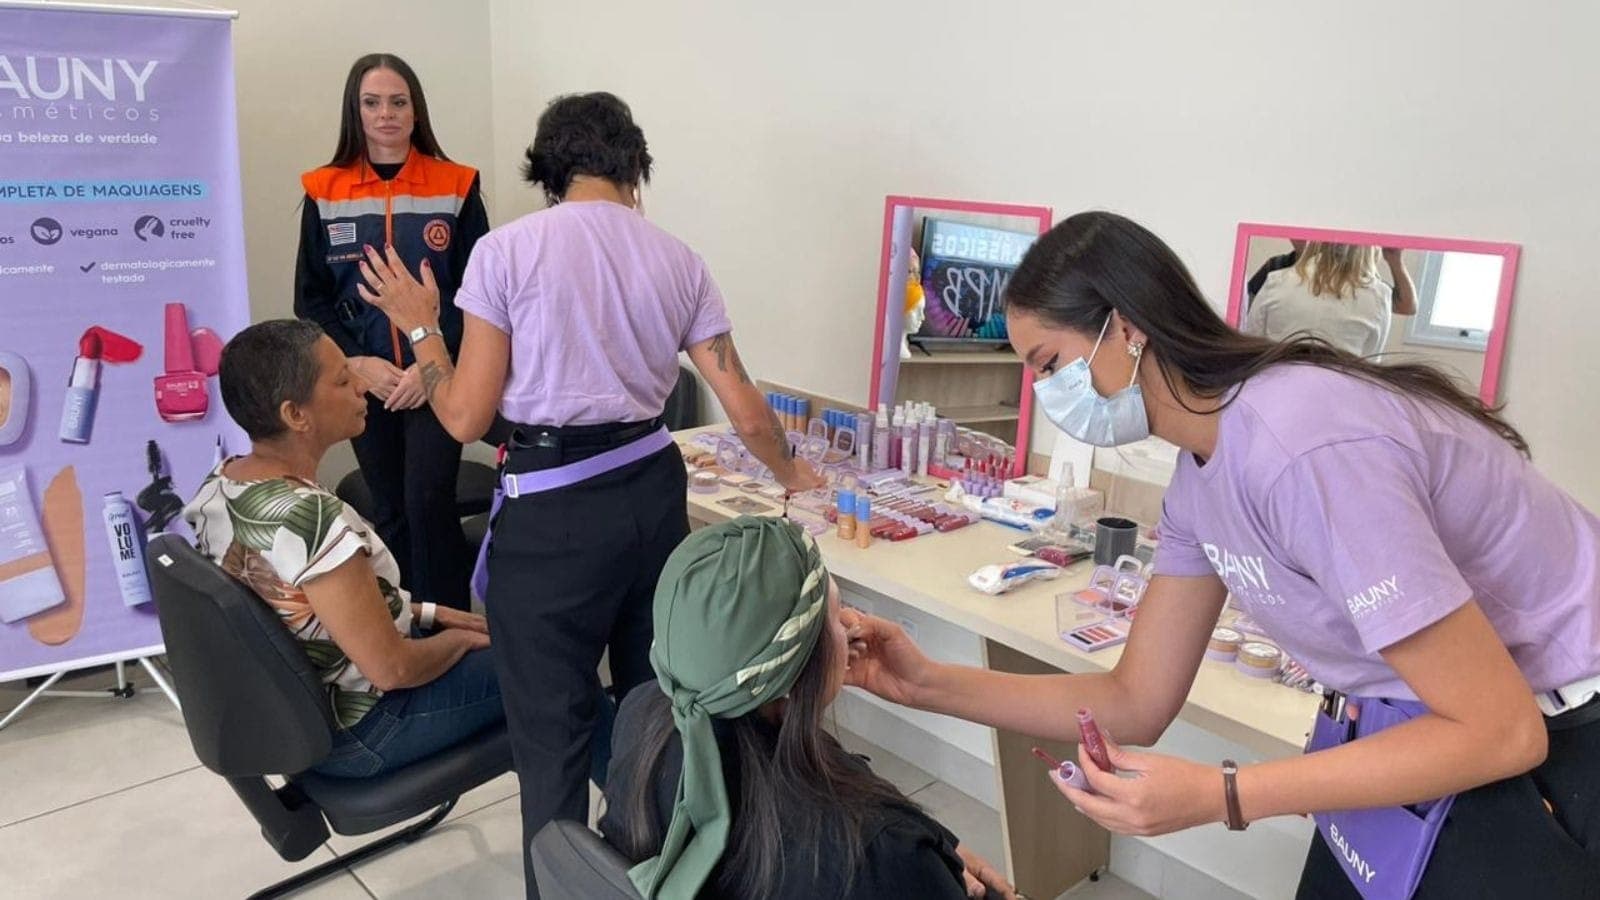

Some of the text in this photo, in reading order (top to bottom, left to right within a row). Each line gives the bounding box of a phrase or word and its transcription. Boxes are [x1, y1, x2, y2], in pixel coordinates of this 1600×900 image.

[0, 55, 159, 102] AUNY
[0, 102, 160, 121] méticos
[18, 131, 69, 143] beleza
[74, 132, 94, 143] de
[99, 133, 158, 144] verdade
[63, 185, 85, 197] DE
[93, 184, 202, 197] MAQUIAGENS
[169, 217, 211, 228] cruelty
[70, 228, 118, 239] vegana
[171, 230, 196, 239] free
[101, 258, 215, 271] dermatologicamente
[102, 273, 145, 283] testado
[114, 523, 131, 537] VO
[117, 536, 133, 549] LU
[120, 548, 136, 560] ME
[1203, 543, 1270, 590] BANY
[1346, 575, 1398, 614] BAUNY
[1329, 823, 1376, 883] BAUNY
